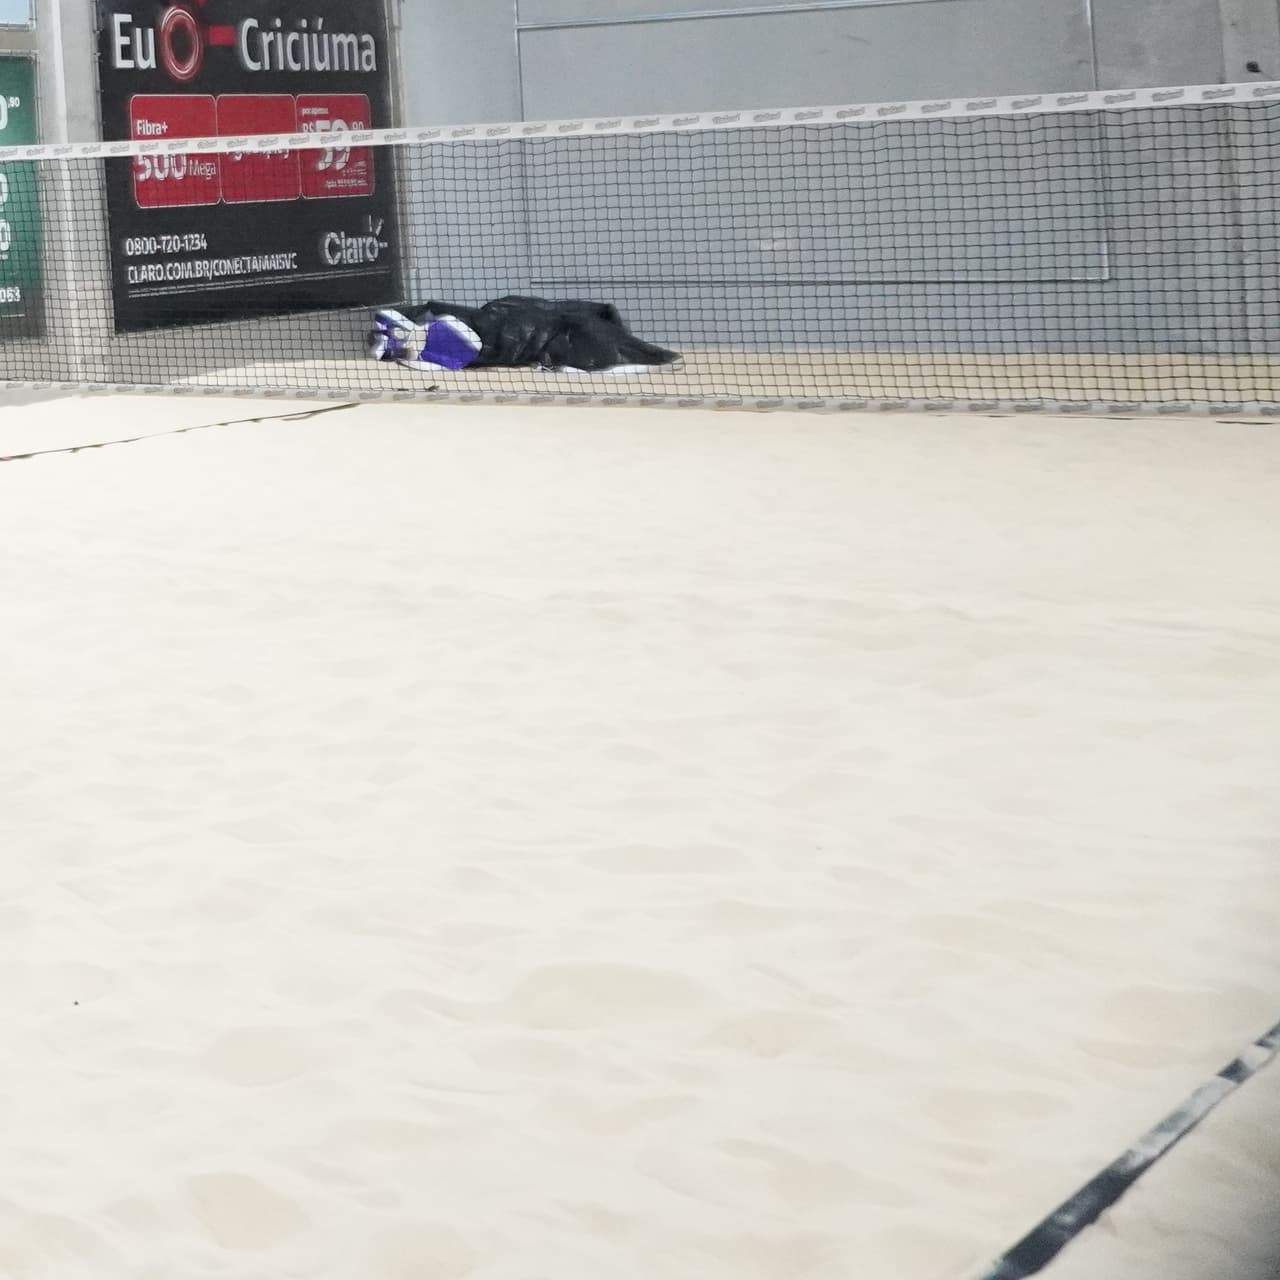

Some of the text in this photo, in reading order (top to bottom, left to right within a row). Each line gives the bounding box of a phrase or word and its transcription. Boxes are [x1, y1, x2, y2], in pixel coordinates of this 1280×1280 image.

[113, 12, 156, 70] Eu
[242, 16, 378, 72] Criciúma
[136, 120, 168, 136] Fibra+
[189, 160, 217, 180] Mega
[324, 230, 380, 266] Claro
